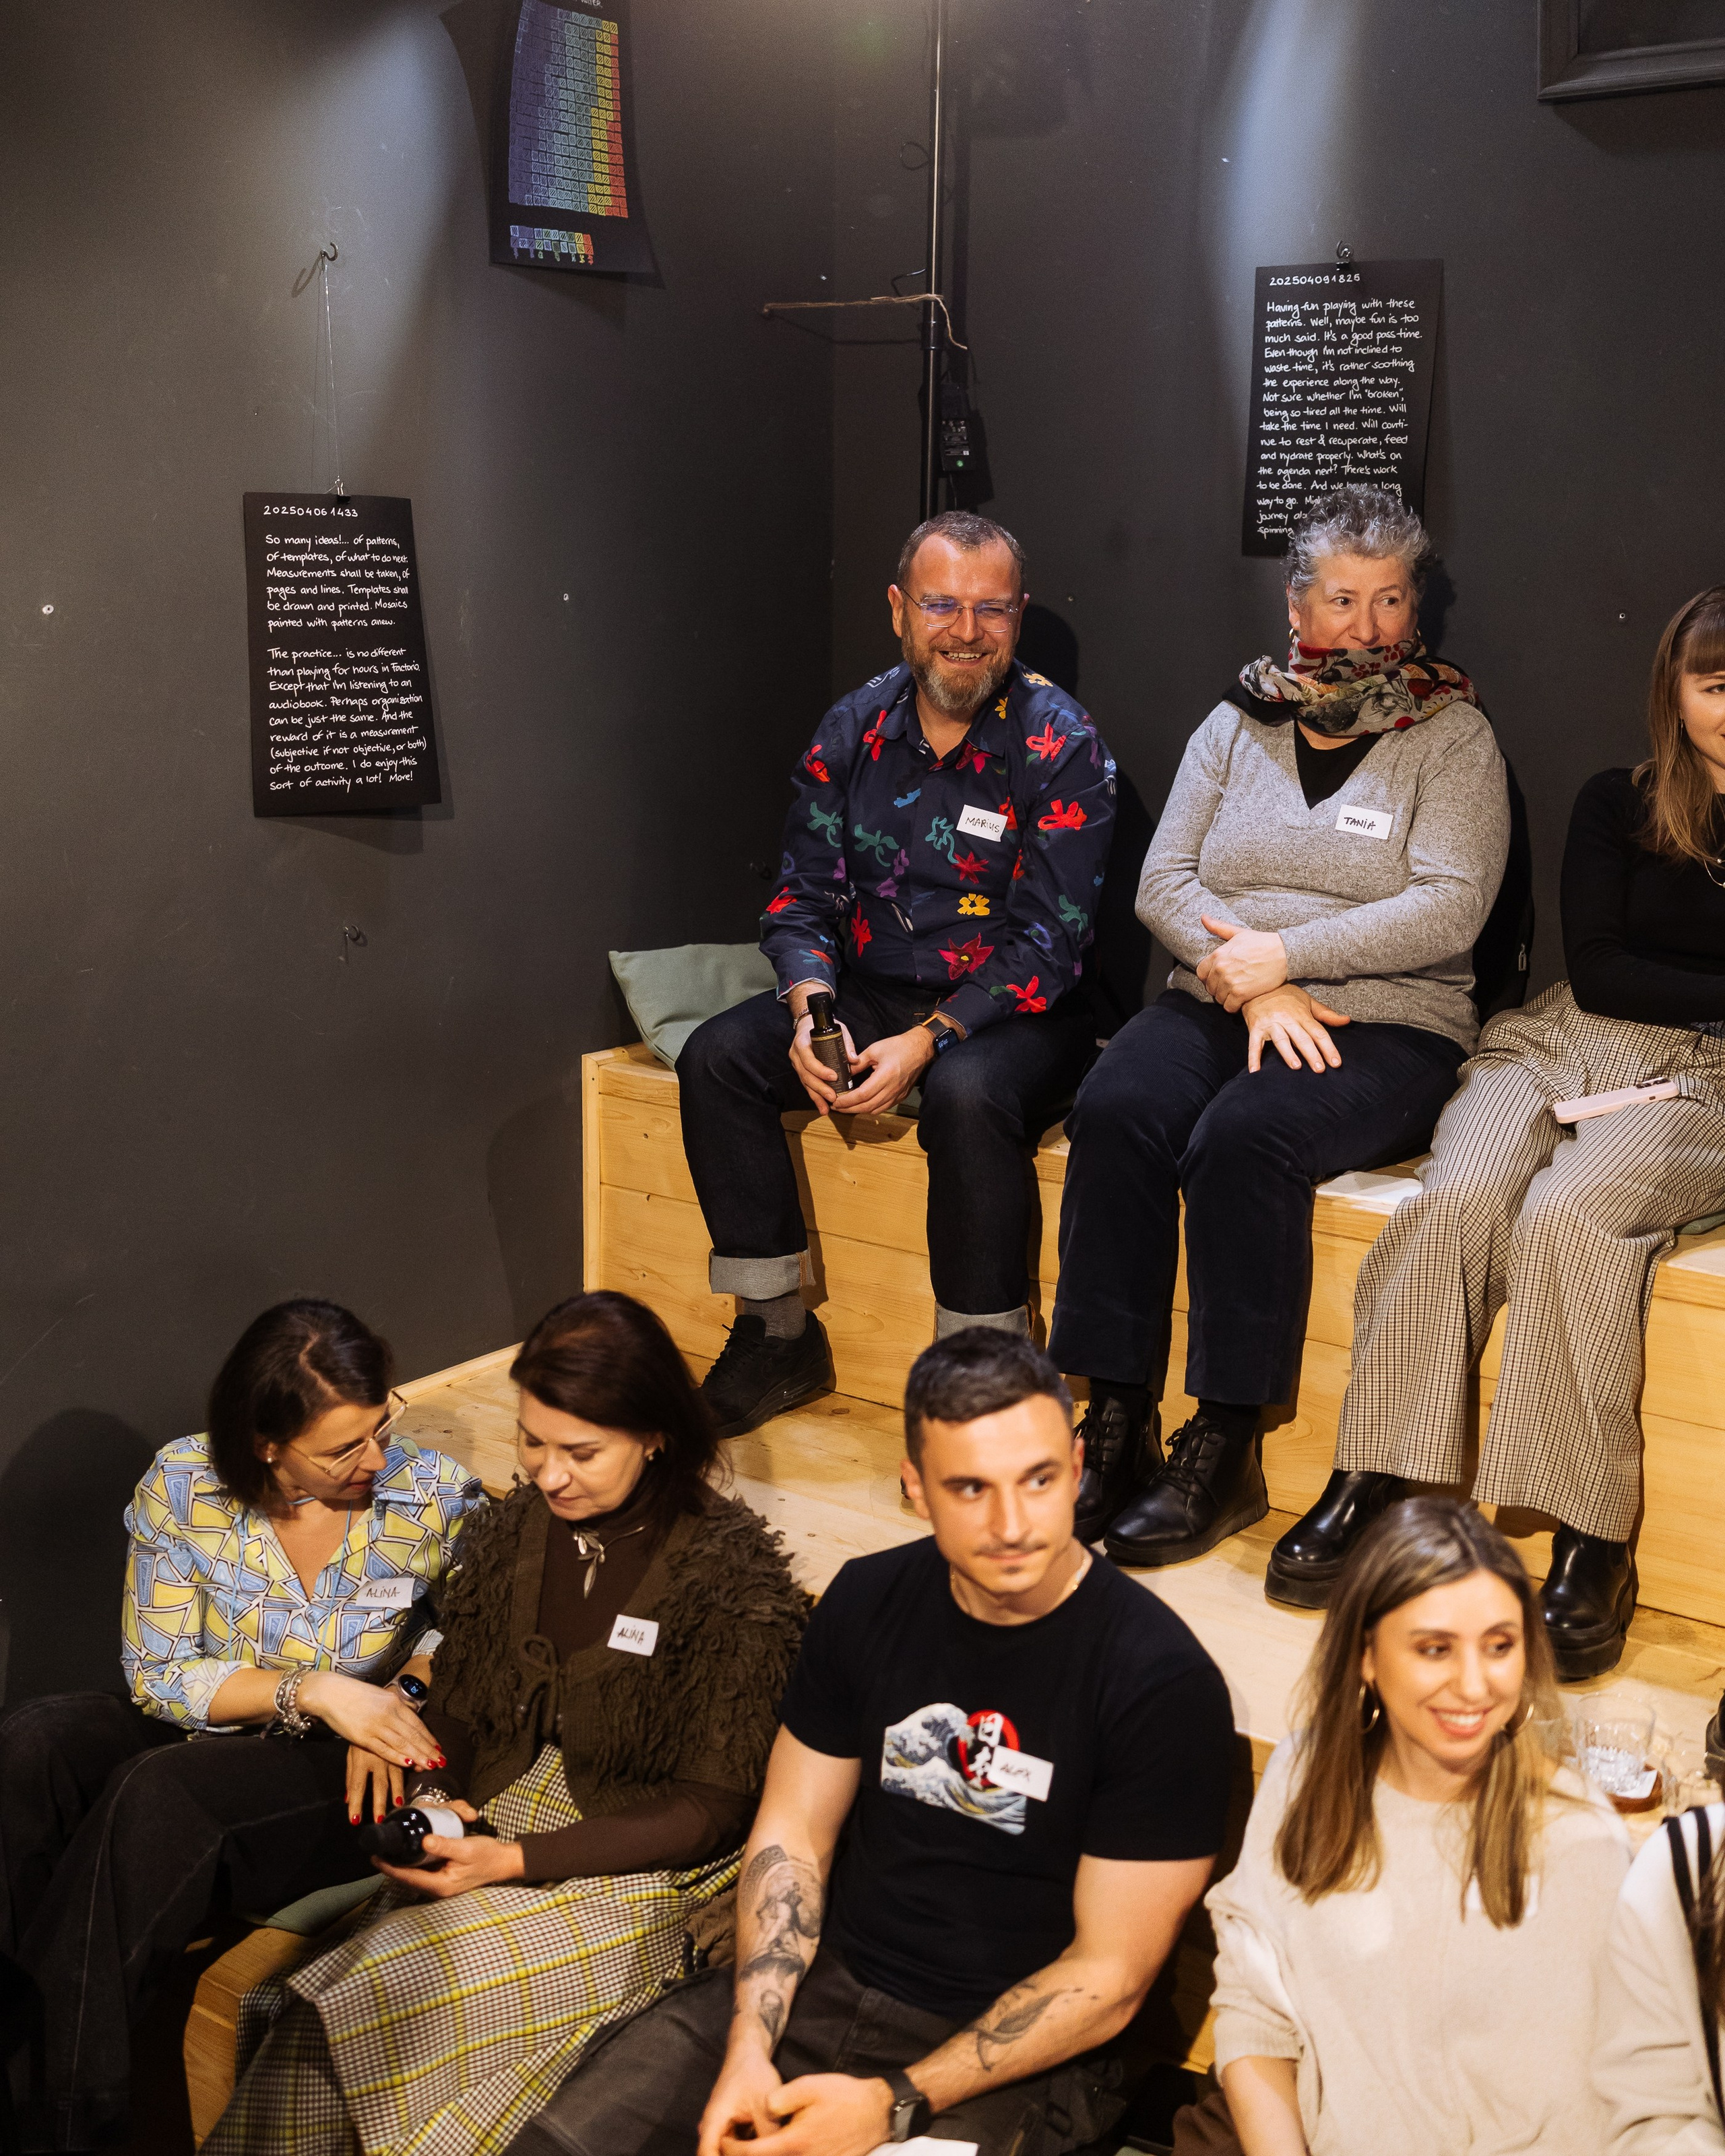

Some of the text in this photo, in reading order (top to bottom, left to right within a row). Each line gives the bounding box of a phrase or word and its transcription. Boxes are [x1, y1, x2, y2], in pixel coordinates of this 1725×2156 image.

[1267, 298, 1415, 319] Having fun playing with these
[1265, 318, 1305, 332] patterns.
[1311, 317, 1332, 327] Well,
[1336, 317, 1366, 331] maybe
[1369, 313, 1385, 323] fun
[1389, 315, 1398, 323] is
[1265, 333, 1290, 343] much
[1294, 333, 1319, 342] said.
[1324, 330, 1337, 341] It's
[1350, 330, 1373, 346] good
[1264, 345, 1388, 362] Even though I'm not inclined
[1265, 363, 1291, 372] waste
[1292, 362, 1318, 373] time,
[1340, 362, 1371, 371] rather
[1372, 358, 1415, 372] soothing
[1263, 376, 1400, 393] the experience along the way.
[1263, 393, 1280, 402] Not
[1281, 393, 1303, 402] sure
[1307, 392, 1346, 402] whether
[1349, 391, 1361, 400] I'm
[1263, 408, 1289, 422] being
[1303, 407, 1327, 416] tired
[1329, 406, 1340, 415] all
[1342, 407, 1357, 415] the
[1360, 406, 1385, 414] time.
[1389, 404, 1407, 412] Will
[1259, 422, 1280, 431] take
[1281, 420, 1298, 431] the
[1300, 420, 1321, 430] time
[1333, 421, 1357, 430] need.
[1361, 419, 1377, 429] Will
[1296, 437, 1316, 445] rest
[1318, 435, 1326, 445] &
[1384, 435, 1408, 444] feed
[1261, 451, 1276, 459] and
[1316, 451, 1353, 465] properly.
[1258, 464, 1398, 482] the agenda next? There's work
[1269, 481, 1280, 489] be
[1282, 481, 1306, 489] done.
[1311, 481, 1327, 490] And
[1381, 482, 1402, 497] long
[1257, 497, 1273, 509] way
[1286, 499, 1298, 509] go.
[1257, 526, 1294, 539] spinning
[265, 535, 280, 544] So
[284, 537, 311, 552] many
[366, 537, 400, 550] patterns,
[267, 552, 280, 561] of
[280, 552, 333, 566] templates,
[336, 551, 347, 561] of
[267, 567, 401, 581] Measurements shall be taken,
[267, 586, 296, 600] pages
[321, 585, 344, 594] lines.
[347, 584, 391, 598] Templates
[394, 585, 408, 594] shall
[268, 602, 280, 611] be
[317, 602, 334, 611] and
[338, 604, 372, 616] printed.
[375, 598, 408, 608] Mosaics
[268, 619, 303, 633] painted
[307, 618, 327, 627] with
[332, 619, 368, 631] patterns
[268, 647, 288, 660] The
[346, 648, 354, 658] is
[371, 647, 406, 657] different
[268, 667, 294, 676] than
[297, 666, 330, 680] playing
[332, 663, 349, 674] for
[353, 664, 379, 673] hours
[270, 681, 305, 697] Except
[305, 682, 330, 692] that
[334, 680, 346, 690] I'm
[350, 680, 387, 693] listening
[270, 699, 327, 709] audiobook.
[330, 697, 368, 711] Perhaps
[270, 718, 288, 726] can
[291, 716, 303, 724] be
[306, 714, 328, 728] just
[382, 710, 397, 722] And
[398, 711, 413, 719] the
[270, 726, 418, 742] reward of it measurement
[271, 748, 319, 762] (subjective
[323, 745, 333, 755] if
[354, 743, 395, 755] objective,
[408, 736, 427, 751] both)
[270, 755, 417, 774] of the outcome. do enjoy this
[299, 778, 313, 788] of
[315, 776, 351, 792] activity
[367, 773, 381, 783] lot!
[389, 771, 413, 782] More!
